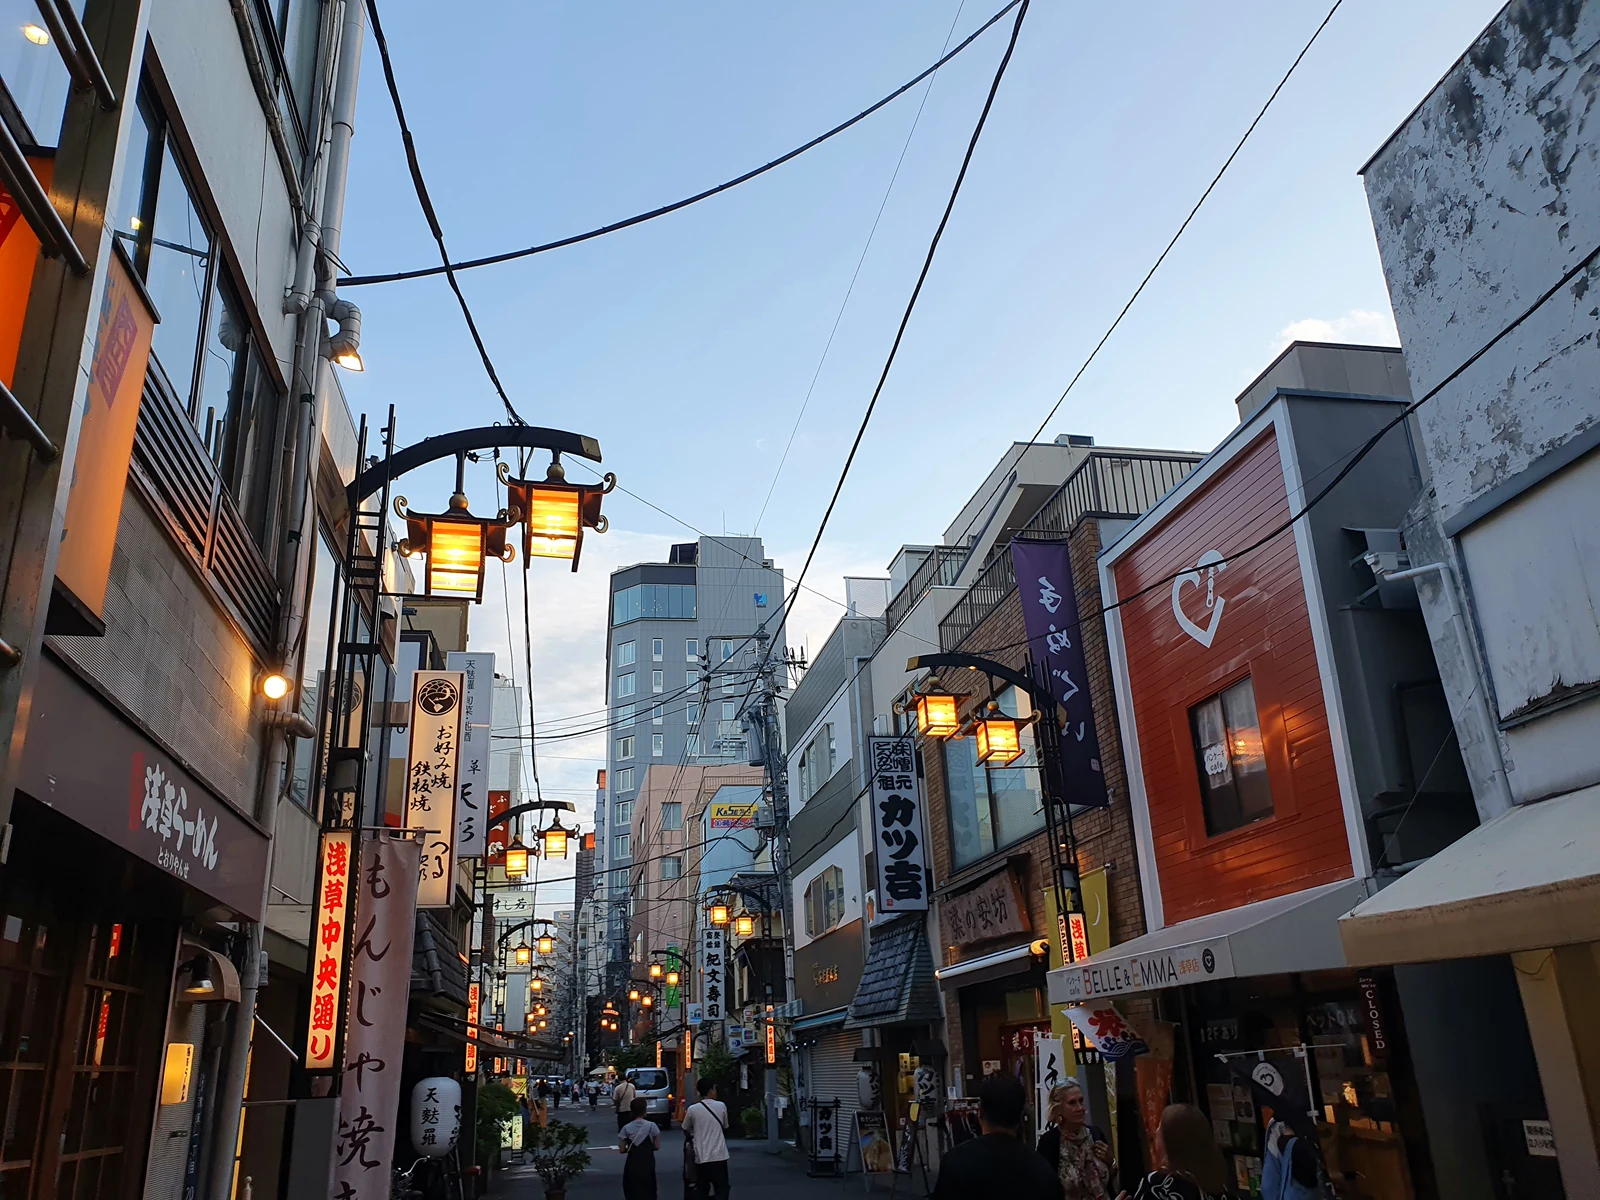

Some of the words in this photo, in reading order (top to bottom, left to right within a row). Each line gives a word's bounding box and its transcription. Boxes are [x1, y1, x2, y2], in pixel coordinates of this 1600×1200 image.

[431, 724, 455, 790] お好み焼
[1211, 761, 1223, 771] cafe
[410, 761, 432, 812] 鉄板焼
[141, 763, 218, 871] 浅草らーめん
[157, 846, 190, 880] とおりやんせ
[879, 794, 923, 902] カツ吉
[493, 896, 528, 912] すし若
[310, 841, 347, 1061] 浅草中央通り
[1069, 986, 1081, 996] cafe
[1083, 966, 1123, 995] BELLE
[1124, 969, 1132, 988] &
[1130, 956, 1179, 989] EMMA
[1178, 959, 1200, 975] 浅草店
[1365, 989, 1386, 1049] CLOSED
[819, 1108, 833, 1150] カツ吉
